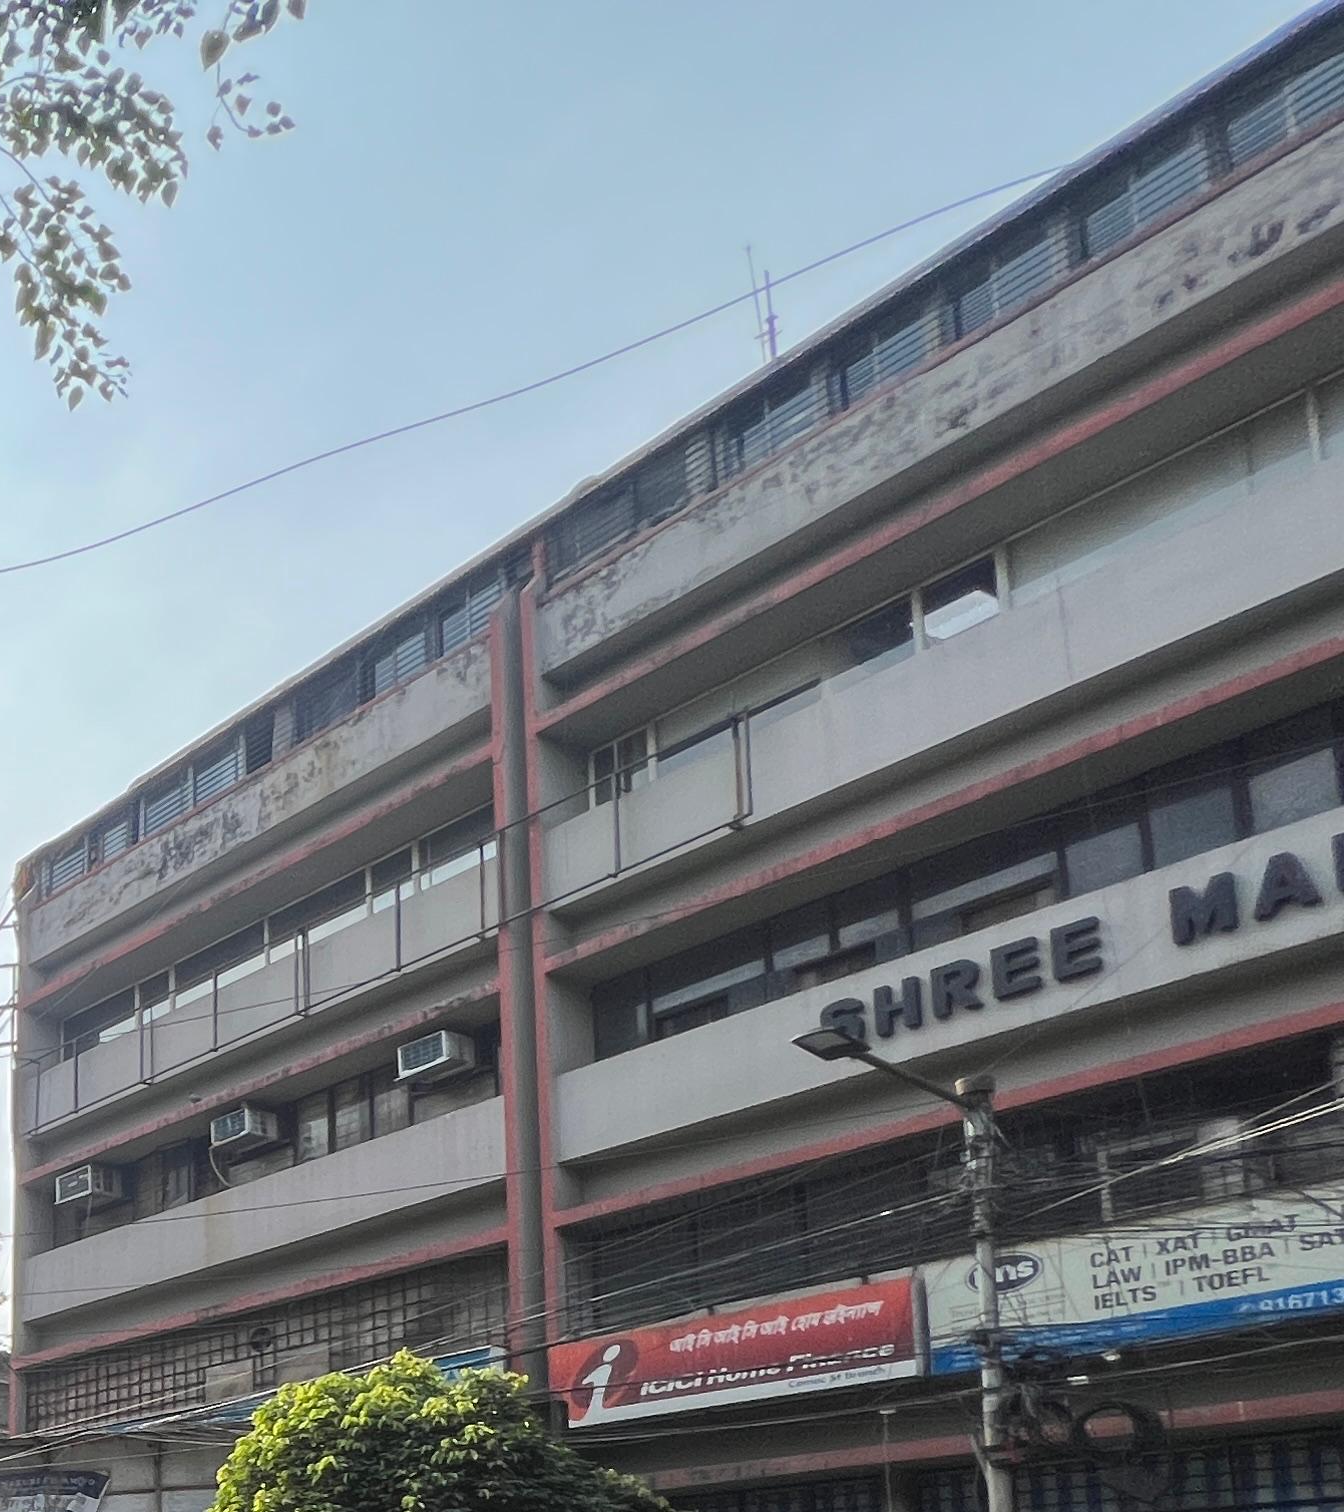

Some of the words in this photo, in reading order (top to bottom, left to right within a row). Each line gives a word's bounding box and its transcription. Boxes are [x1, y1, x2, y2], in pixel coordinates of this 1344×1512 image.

[820, 916, 1105, 1042] SHREE
[1169, 832, 1344, 946] MA
[1090, 1246, 1134, 1268] CAT
[1156, 1233, 1206, 1256] XAT
[1092, 1266, 1142, 1290] LAW
[1165, 1242, 1275, 1277] IPM-BBA
[1094, 1286, 1157, 1311] IELTS
[1193, 1266, 1270, 1293] TOEFL
